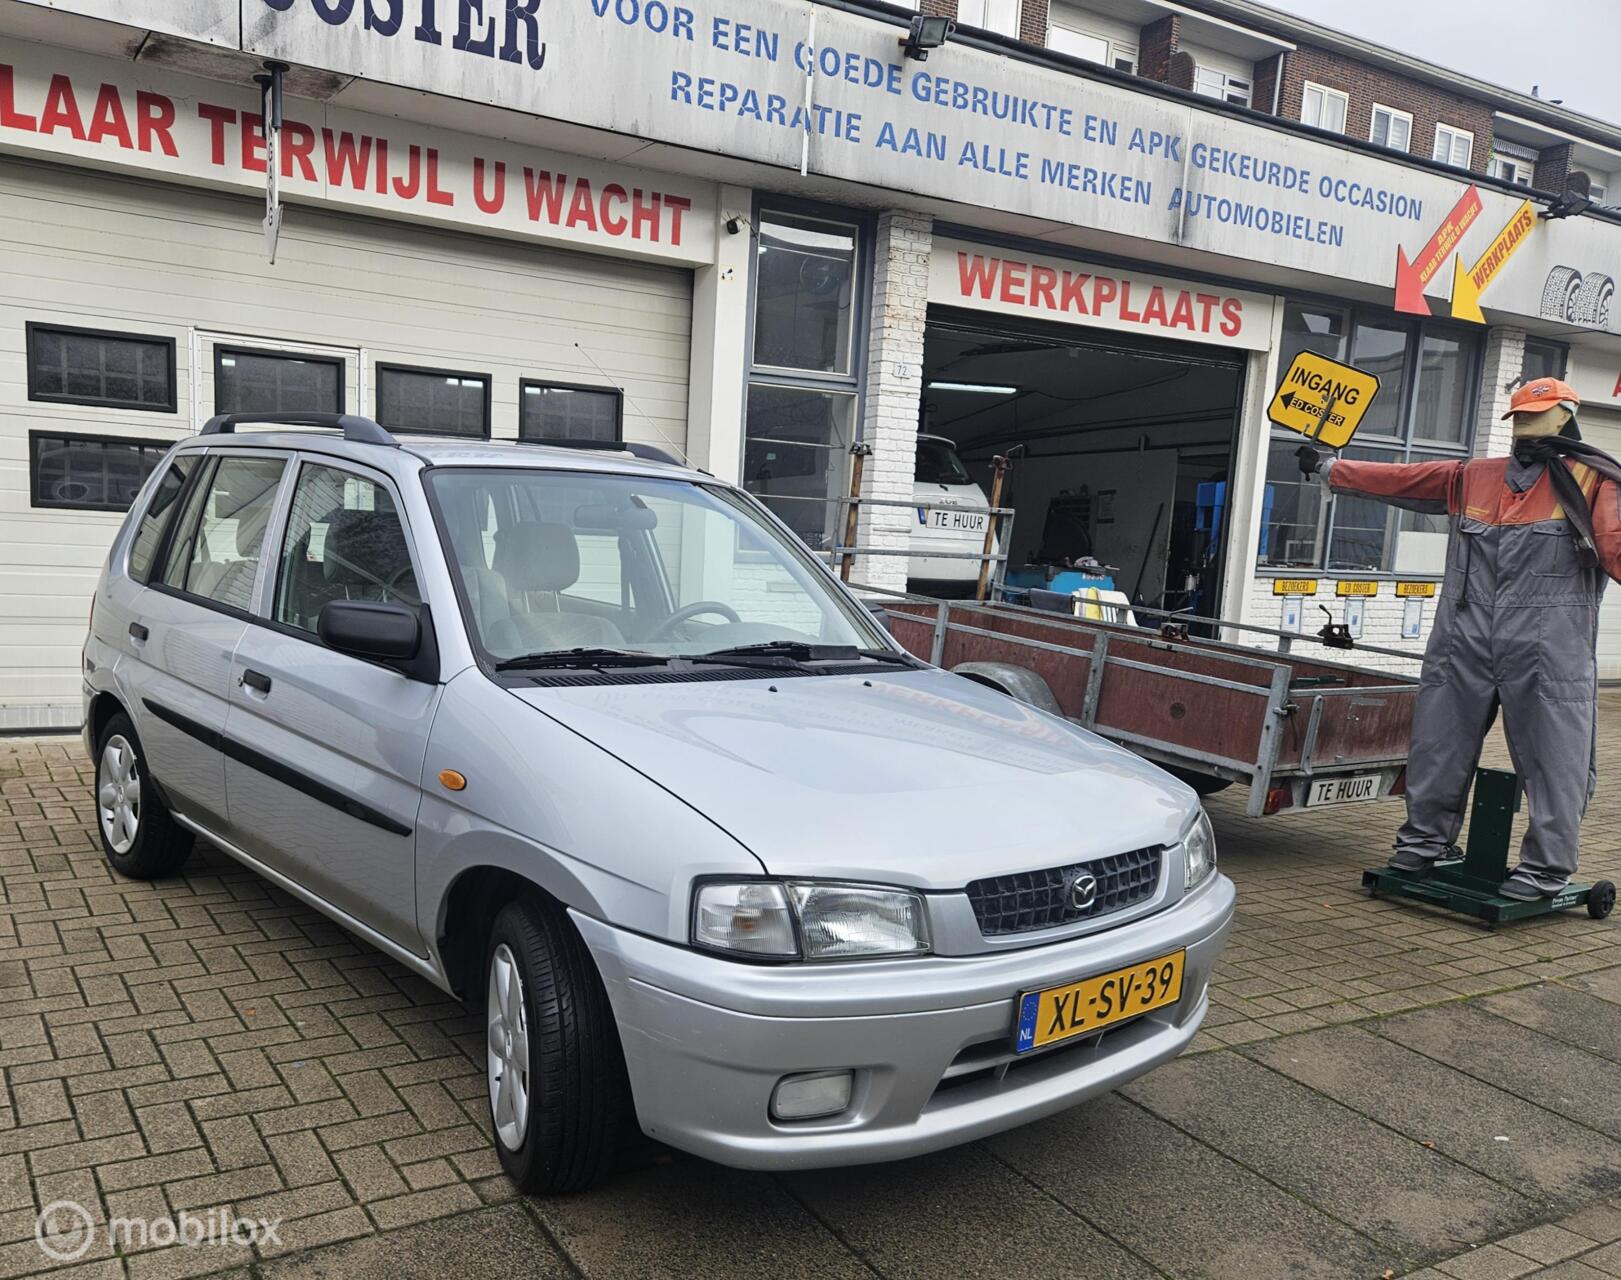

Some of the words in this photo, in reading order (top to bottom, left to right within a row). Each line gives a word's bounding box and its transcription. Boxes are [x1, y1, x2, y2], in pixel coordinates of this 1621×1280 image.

[260, 0, 546, 70] TER
[591, 0, 695, 41] VOOR
[712, 17, 779, 62] EEN
[794, 41, 903, 95] GOEDE
[911, 71, 1073, 137] GEBRUIKTE
[1083, 115, 1117, 146] EN
[1127, 127, 1180, 162] APK
[1191, 143, 1311, 194] GEKEURDE
[1318, 175, 1423, 221] OCCASION
[0, 63, 179, 158] LAAR
[198, 102, 455, 208] TERWIJL
[472, 157, 506, 214] U
[523, 166, 692, 246] WACHT
[670, 71, 862, 143] REPARATIE
[875, 121, 947, 161] AAN
[958, 141, 1030, 180] ALLE
[1040, 159, 1152, 206] MERKEN
[1168, 187, 1344, 247] AUTOMOBIELEN
[1437, 220, 1454, 246] APK
[1472, 210, 1532, 290] WERKPLAATS
[957, 251, 1243, 337] WERKPLAATS
[1290, 366, 1360, 405] INGANG
[1290, 398, 1304, 409] ED
[1304, 404, 1343, 425] COSER
[935, 512, 948, 526] TE
[953, 513, 984, 529] HUUR
[1281, 580, 1310, 592] BEZOEKERS
[1318, 783, 1333, 801] TE
[1336, 779, 1373, 799] HUUR
[1047, 961, 1174, 1035] XL-SV-39
[1019, 1029, 1032, 1041] NL
